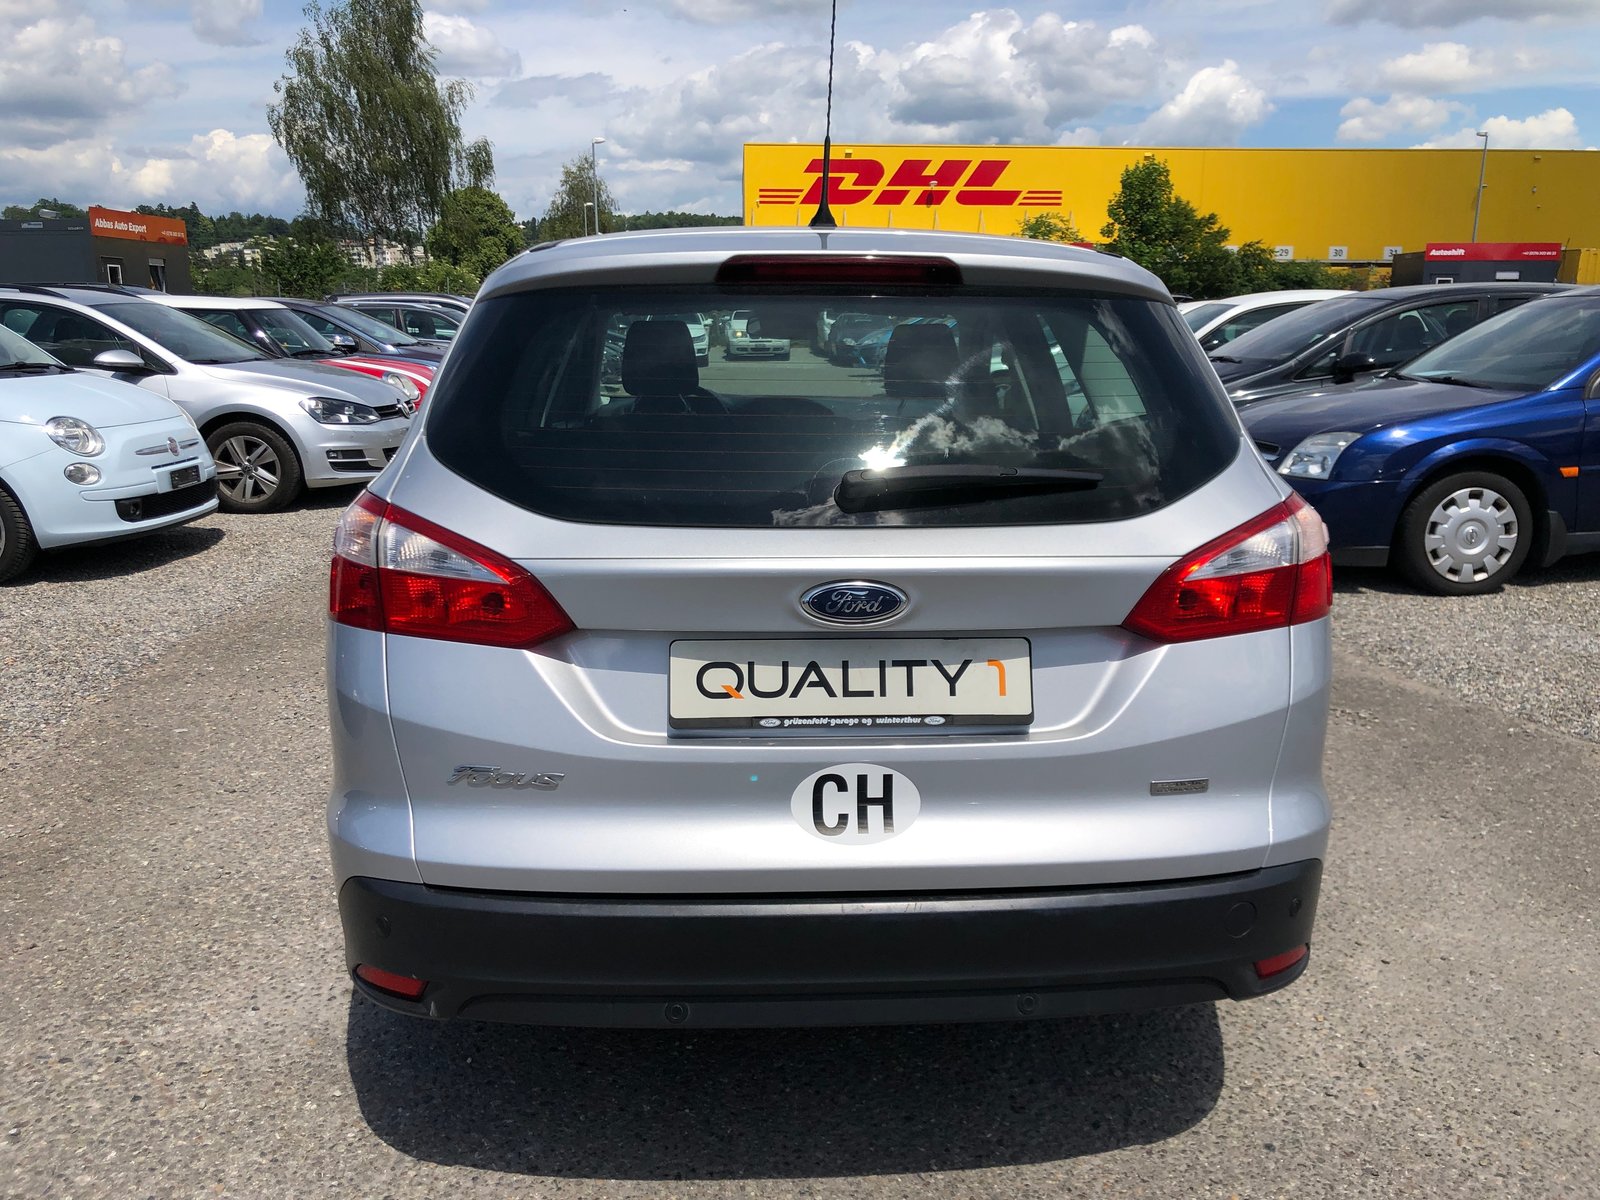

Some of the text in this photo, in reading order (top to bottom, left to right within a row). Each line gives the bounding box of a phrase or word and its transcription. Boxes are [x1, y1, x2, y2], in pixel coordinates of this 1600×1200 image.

[799, 158, 1023, 206] DHL
[95, 218, 114, 229] Abbas
[114, 220, 128, 231] Auto
[128, 222, 147, 234] Export
[1278, 248, 1289, 257] 29
[1332, 248, 1344, 257] 30
[1429, 248, 1466, 256] Autoshift
[825, 589, 884, 613] Ford
[696, 658, 1007, 700] QUALITY 1
[861, 717, 873, 726] ag
[876, 716, 922, 725] winterthur
[446, 764, 566, 792] Focus
[811, 772, 895, 837] CH
